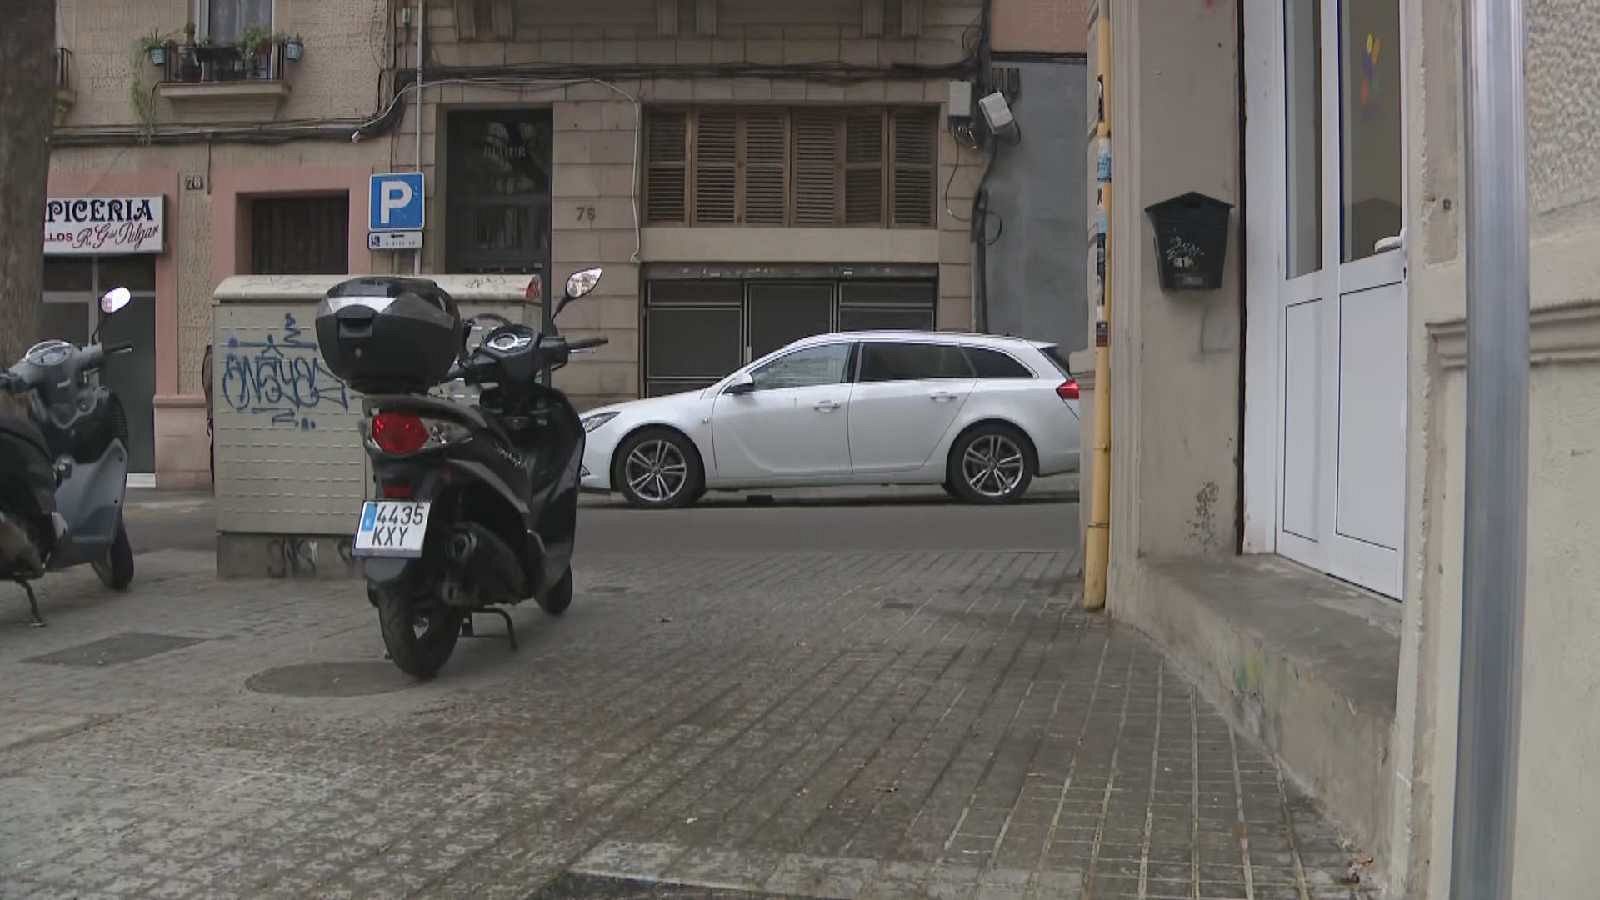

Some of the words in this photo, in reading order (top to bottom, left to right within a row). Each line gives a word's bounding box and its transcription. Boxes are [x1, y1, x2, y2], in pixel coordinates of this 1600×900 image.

[46, 199, 153, 222] PICERIA
[380, 180, 412, 223] P
[45, 231, 73, 242] LOS
[377, 503, 424, 525] 4435
[372, 526, 408, 546] KXY
